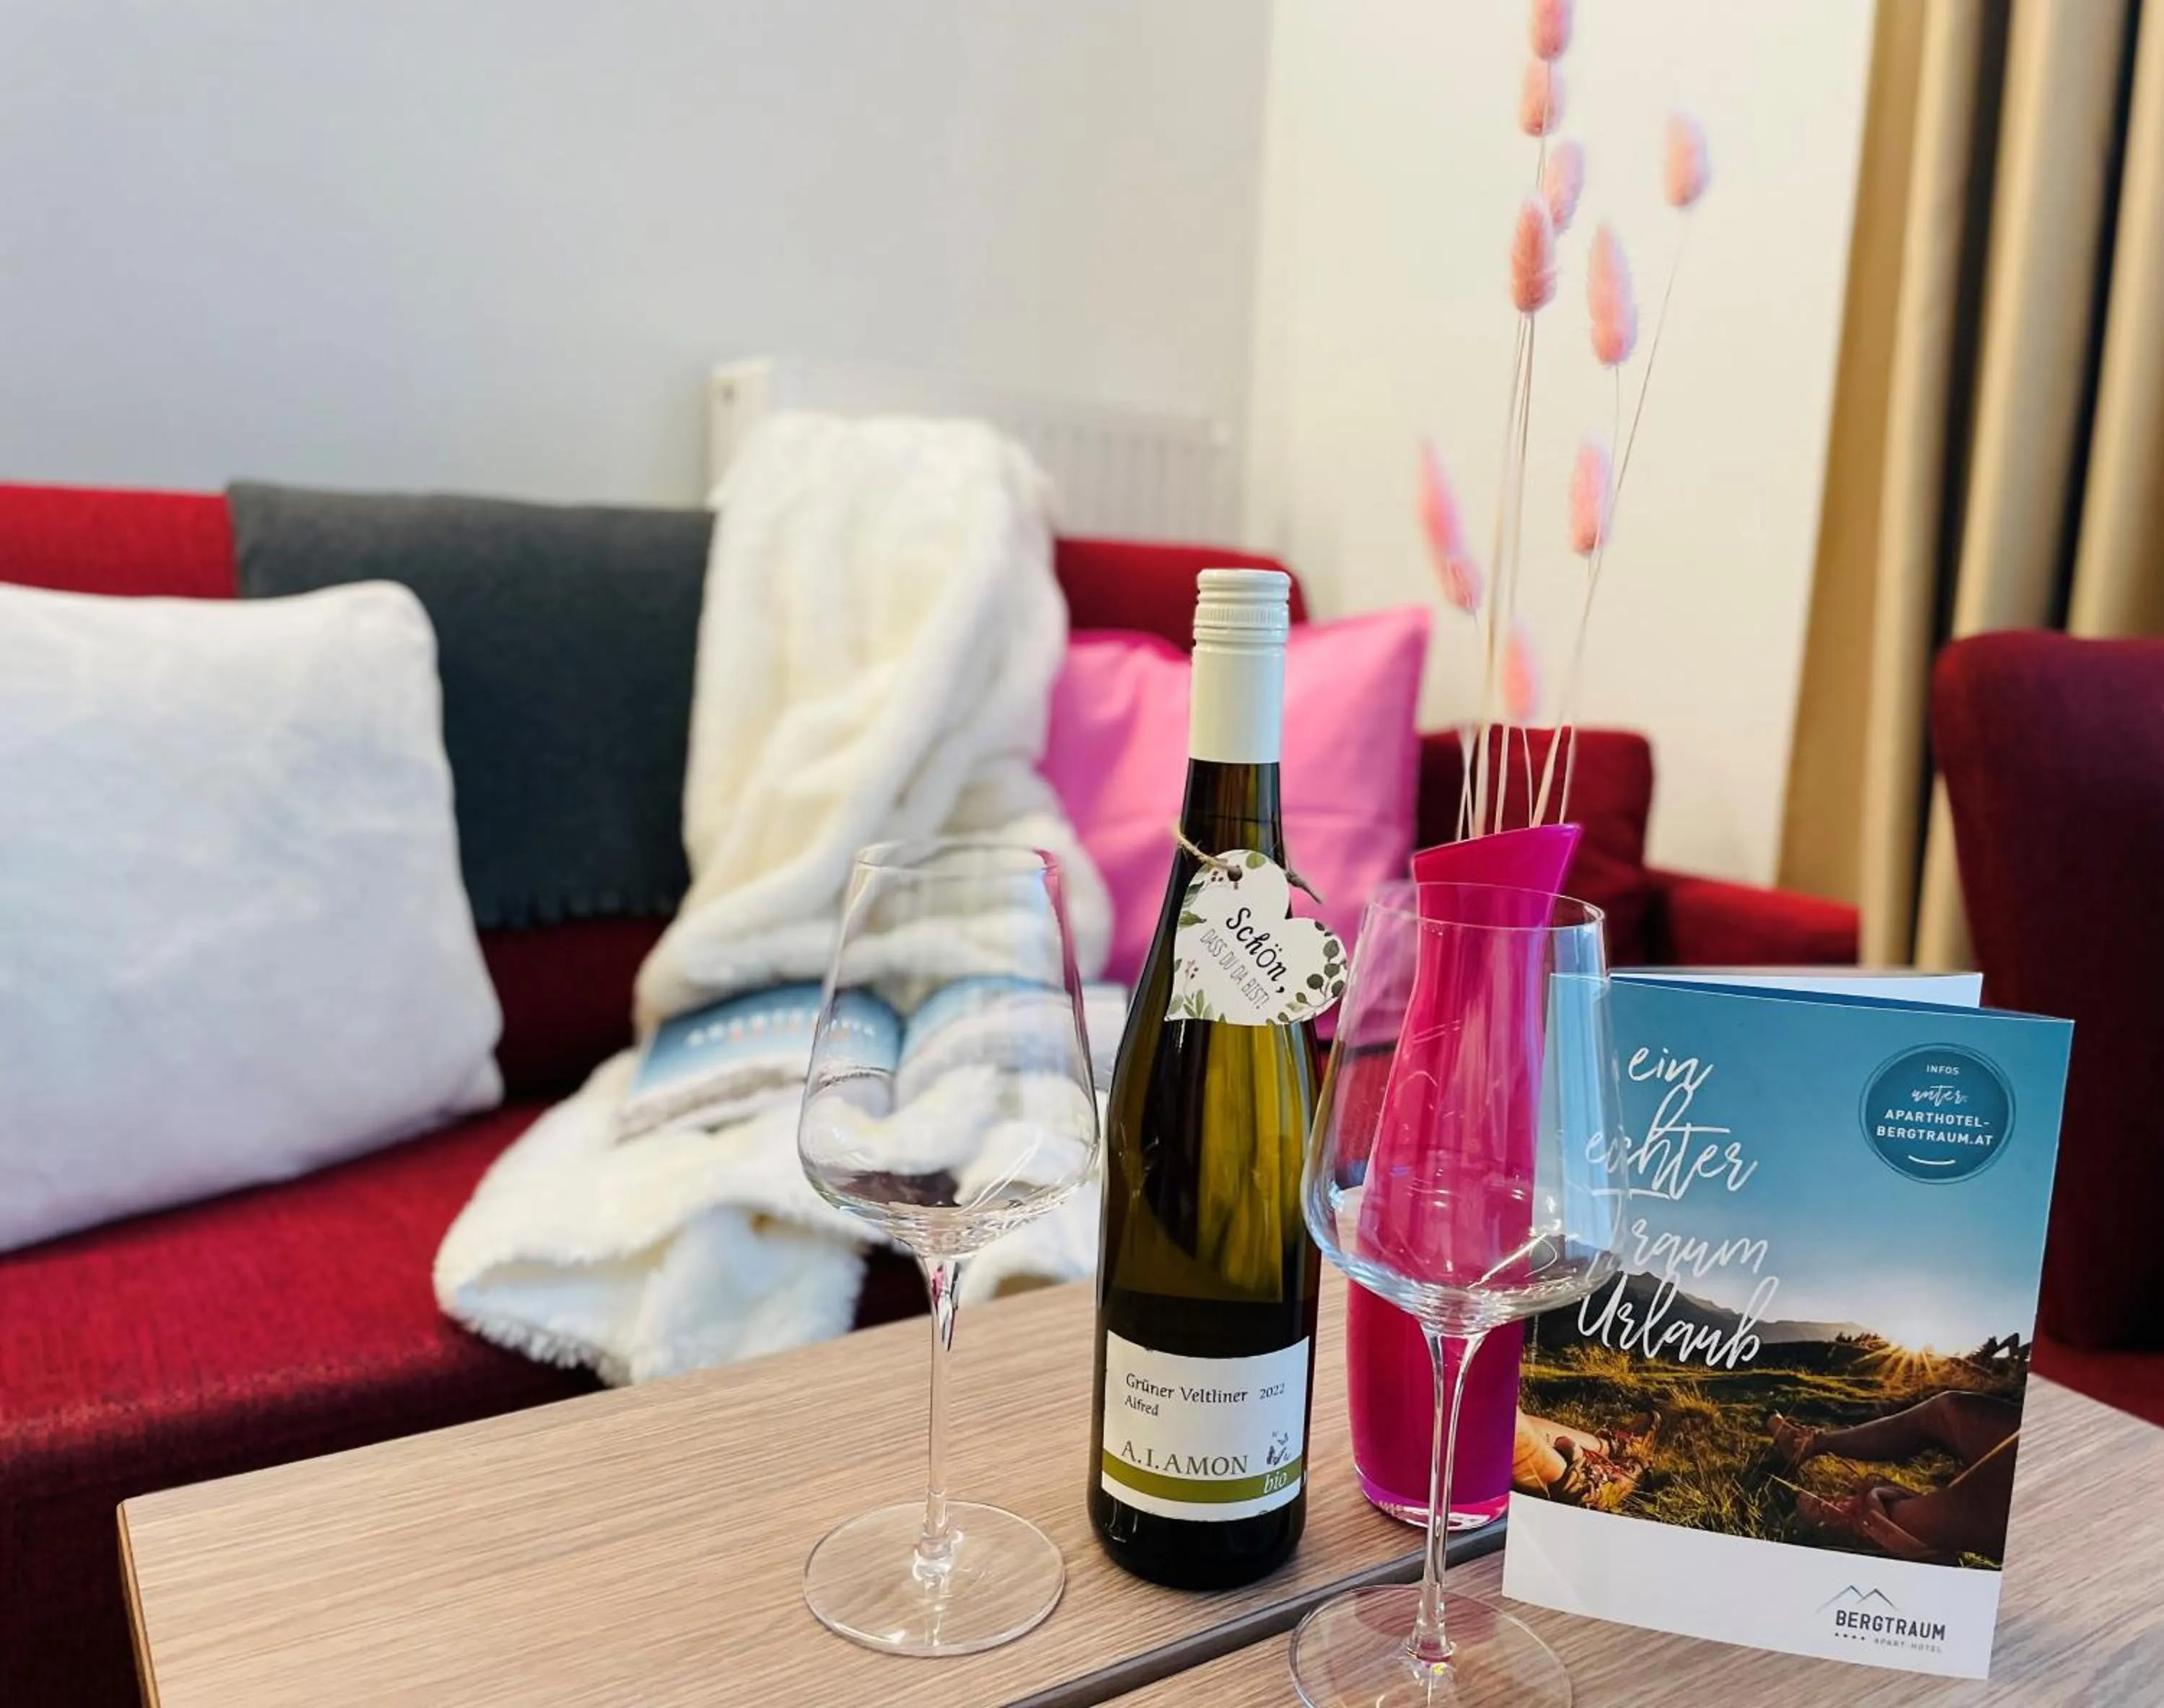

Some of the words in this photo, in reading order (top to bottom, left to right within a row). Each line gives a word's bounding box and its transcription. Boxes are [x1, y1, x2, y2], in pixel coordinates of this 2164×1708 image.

[1226, 906, 1288, 993] Schön,
[1200, 928, 1228, 957] DASS
[1218, 950, 1239, 971] DU
[1230, 964, 1249, 985] DA
[1241, 977, 1270, 1010] BIST!
[1627, 1047, 1714, 1096] ein
[1926, 1065, 1960, 1075] INFOS
[1884, 1109, 1990, 1128] APARTHOTEL-
[1876, 1125, 1994, 1146] BERGTRAUM.AT
[1577, 1250, 1780, 1370] Urlaub
[1126, 1373, 1175, 1399] Grüner
[1180, 1386, 1248, 1404] Veltliner
[1259, 1383, 1286, 1399] 2022
[1125, 1394, 1159, 1417] Alfred
[1264, 1471, 1288, 1494] bio
[1835, 1609, 1946, 1641] BERGTRAUM
[1874, 1638, 1906, 1648] APART
[1911, 1643, 1943, 1654] HOTEL
